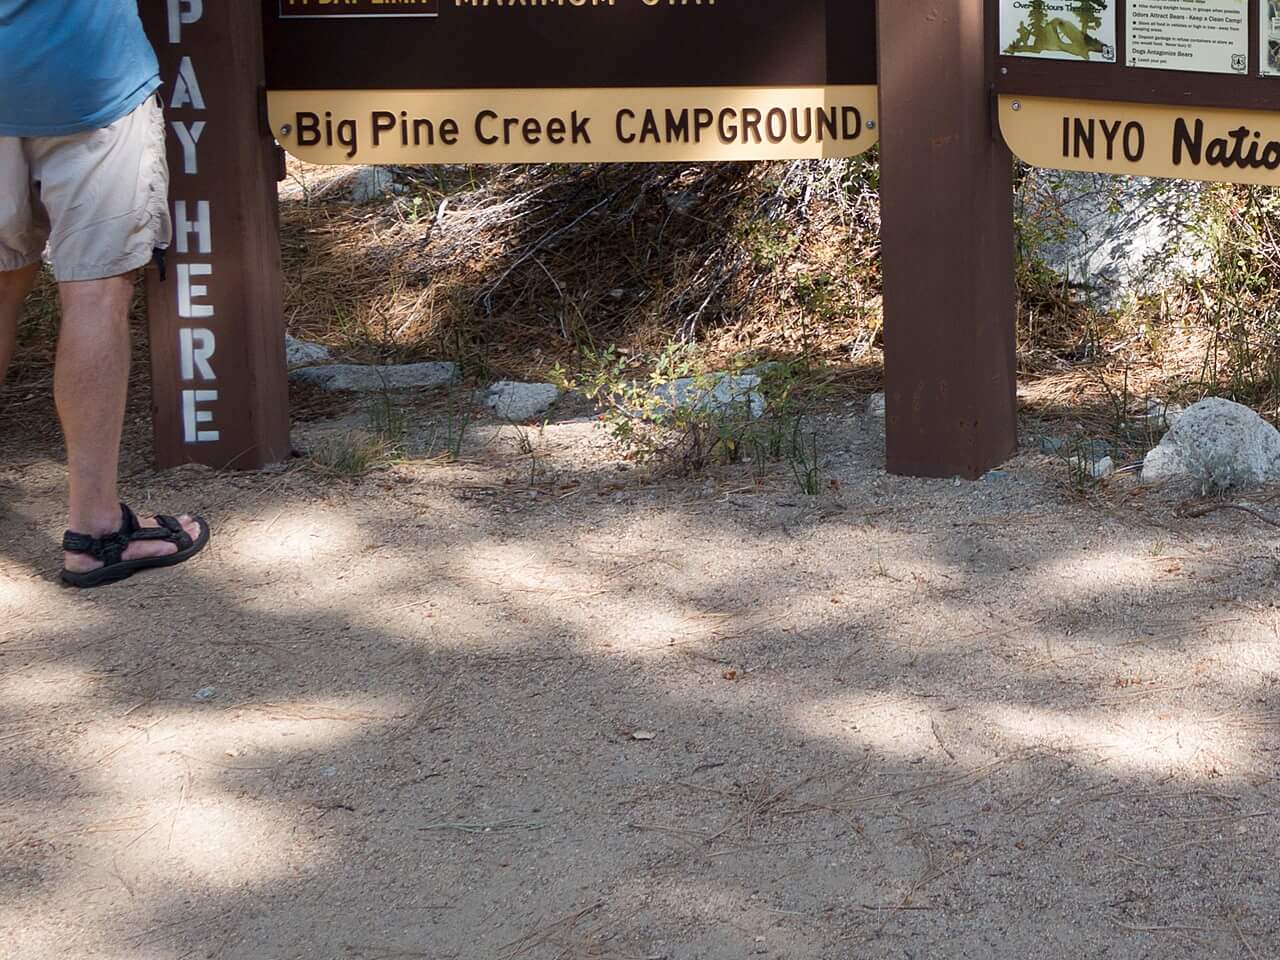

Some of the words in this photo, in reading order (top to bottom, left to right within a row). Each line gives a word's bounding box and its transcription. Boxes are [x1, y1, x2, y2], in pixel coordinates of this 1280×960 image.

[295, 111, 357, 157] Big
[371, 110, 459, 147] Pine
[474, 109, 592, 146] Creek
[615, 105, 862, 145] CAMPGROUND
[1062, 116, 1145, 162] INYO
[175, 200, 220, 443] HERE
